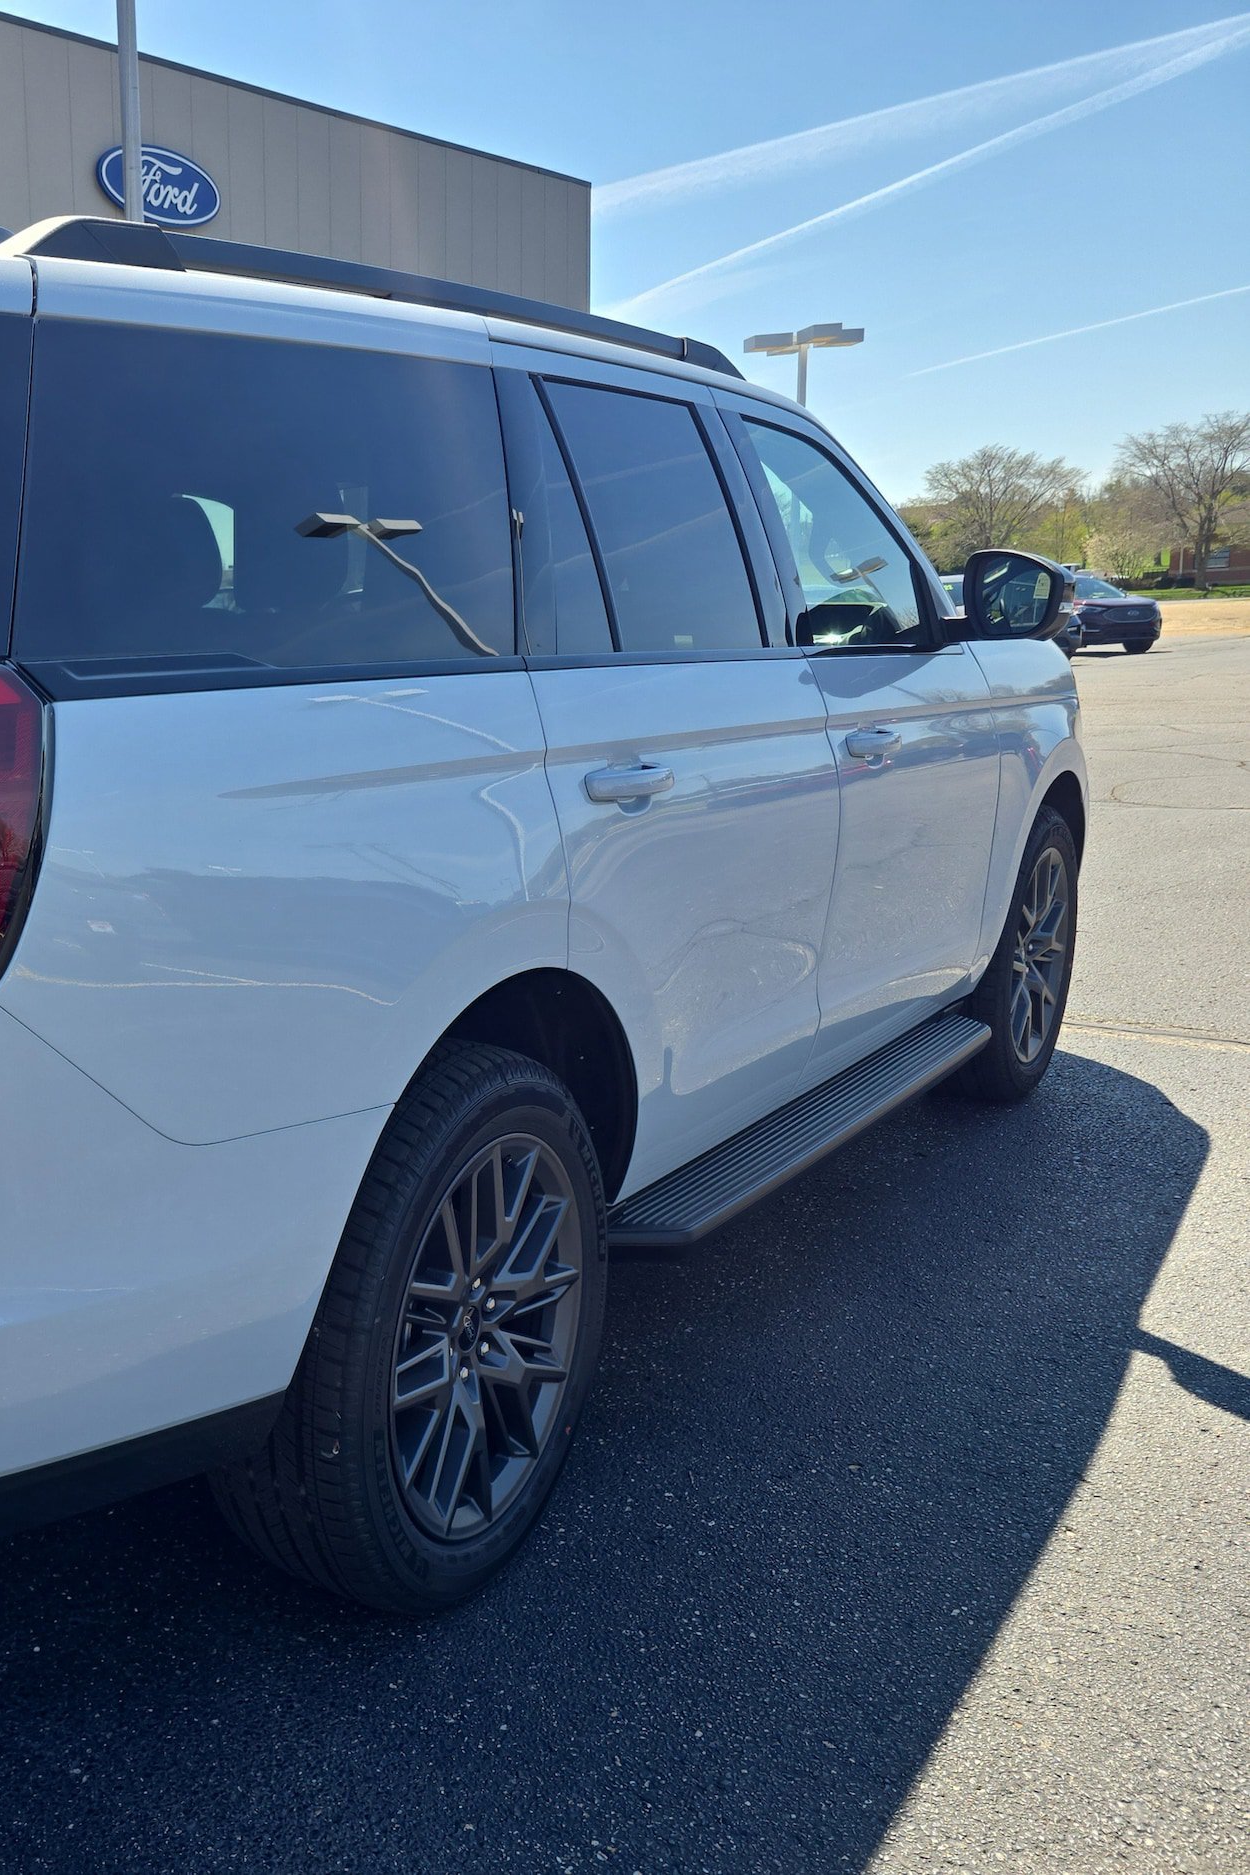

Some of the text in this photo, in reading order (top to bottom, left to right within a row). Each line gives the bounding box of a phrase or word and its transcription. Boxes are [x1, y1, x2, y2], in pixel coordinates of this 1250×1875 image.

[140, 155, 200, 216] Ford
[580, 1144, 606, 1255] MICHELIN
[375, 1438, 414, 1560] MICHELIN
